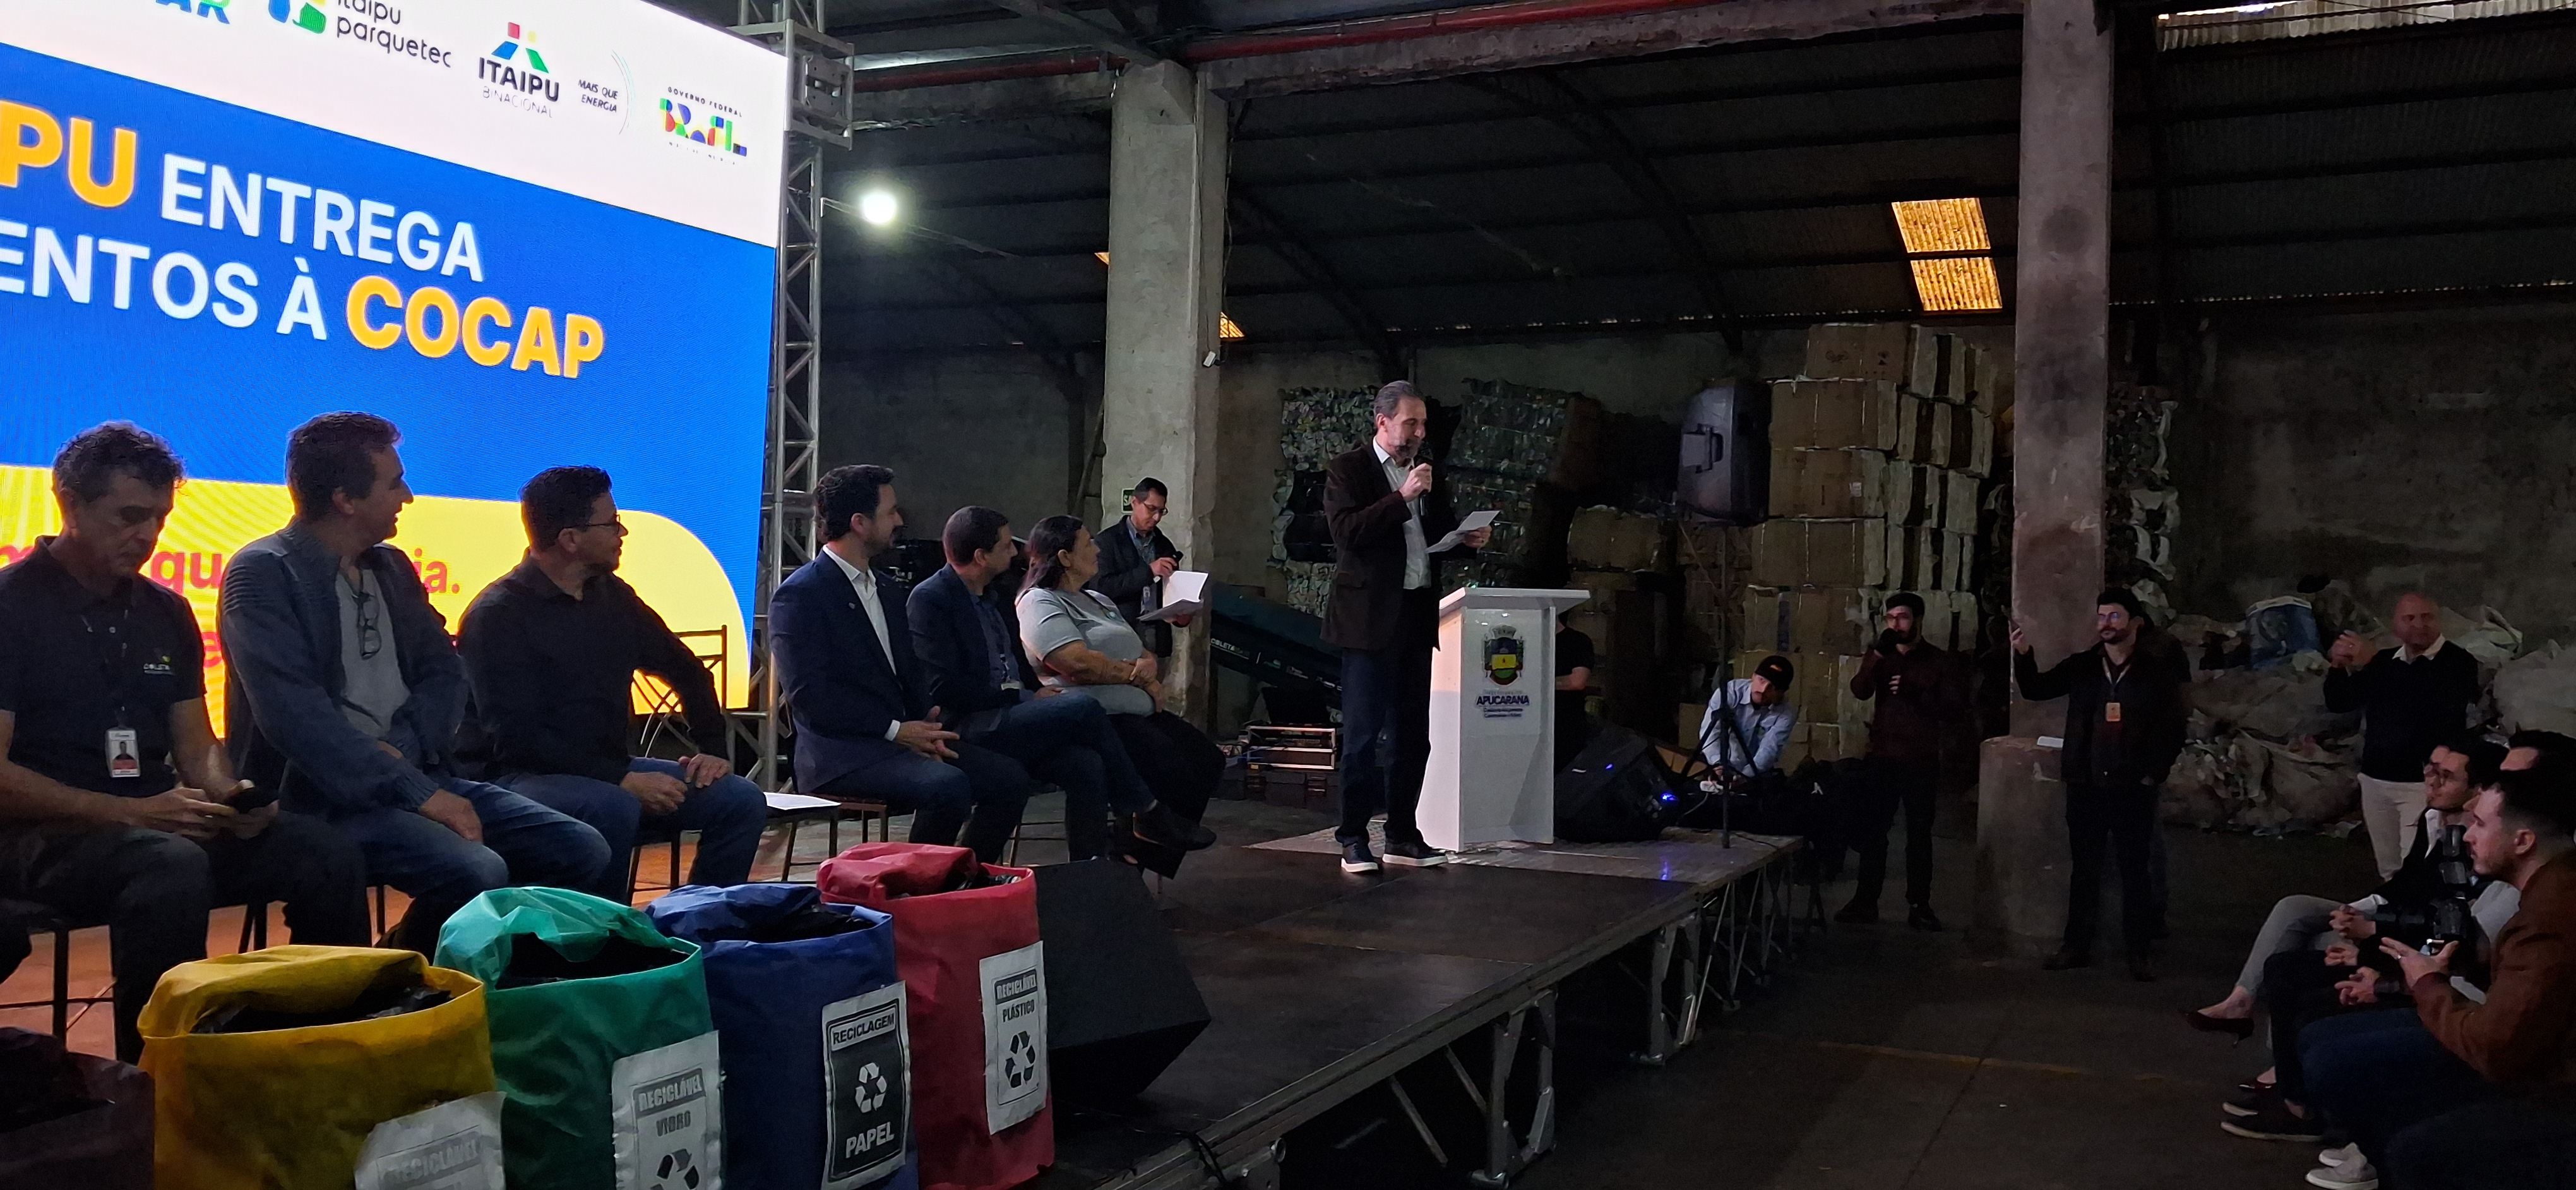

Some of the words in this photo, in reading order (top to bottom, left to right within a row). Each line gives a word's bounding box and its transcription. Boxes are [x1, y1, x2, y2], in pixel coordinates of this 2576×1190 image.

[337, 16, 451, 68] parquetec
[479, 57, 559, 102] ITAIPU
[578, 79, 599, 93] MAIS
[602, 87, 618, 100] QUE
[482, 86, 552, 118] BINACIONAL
[581, 94, 617, 113] ENERGIA
[667, 86, 706, 104] GOVERNO
[709, 100, 742, 117] FEDERAL
[161, 153, 484, 283] ENTREGA
[277, 256, 327, 340] À
[346, 275, 604, 378] COCAP
[1476, 695, 1530, 706] APUCARANA
[1002, 999, 1035, 1023] PLÁSTICO
[833, 1013, 895, 1045] RECICLAGEM
[638, 1074, 703, 1112] RECICLÁVEL
[656, 1110, 691, 1137] VIDRO
[846, 1122, 895, 1158] PAPEL
